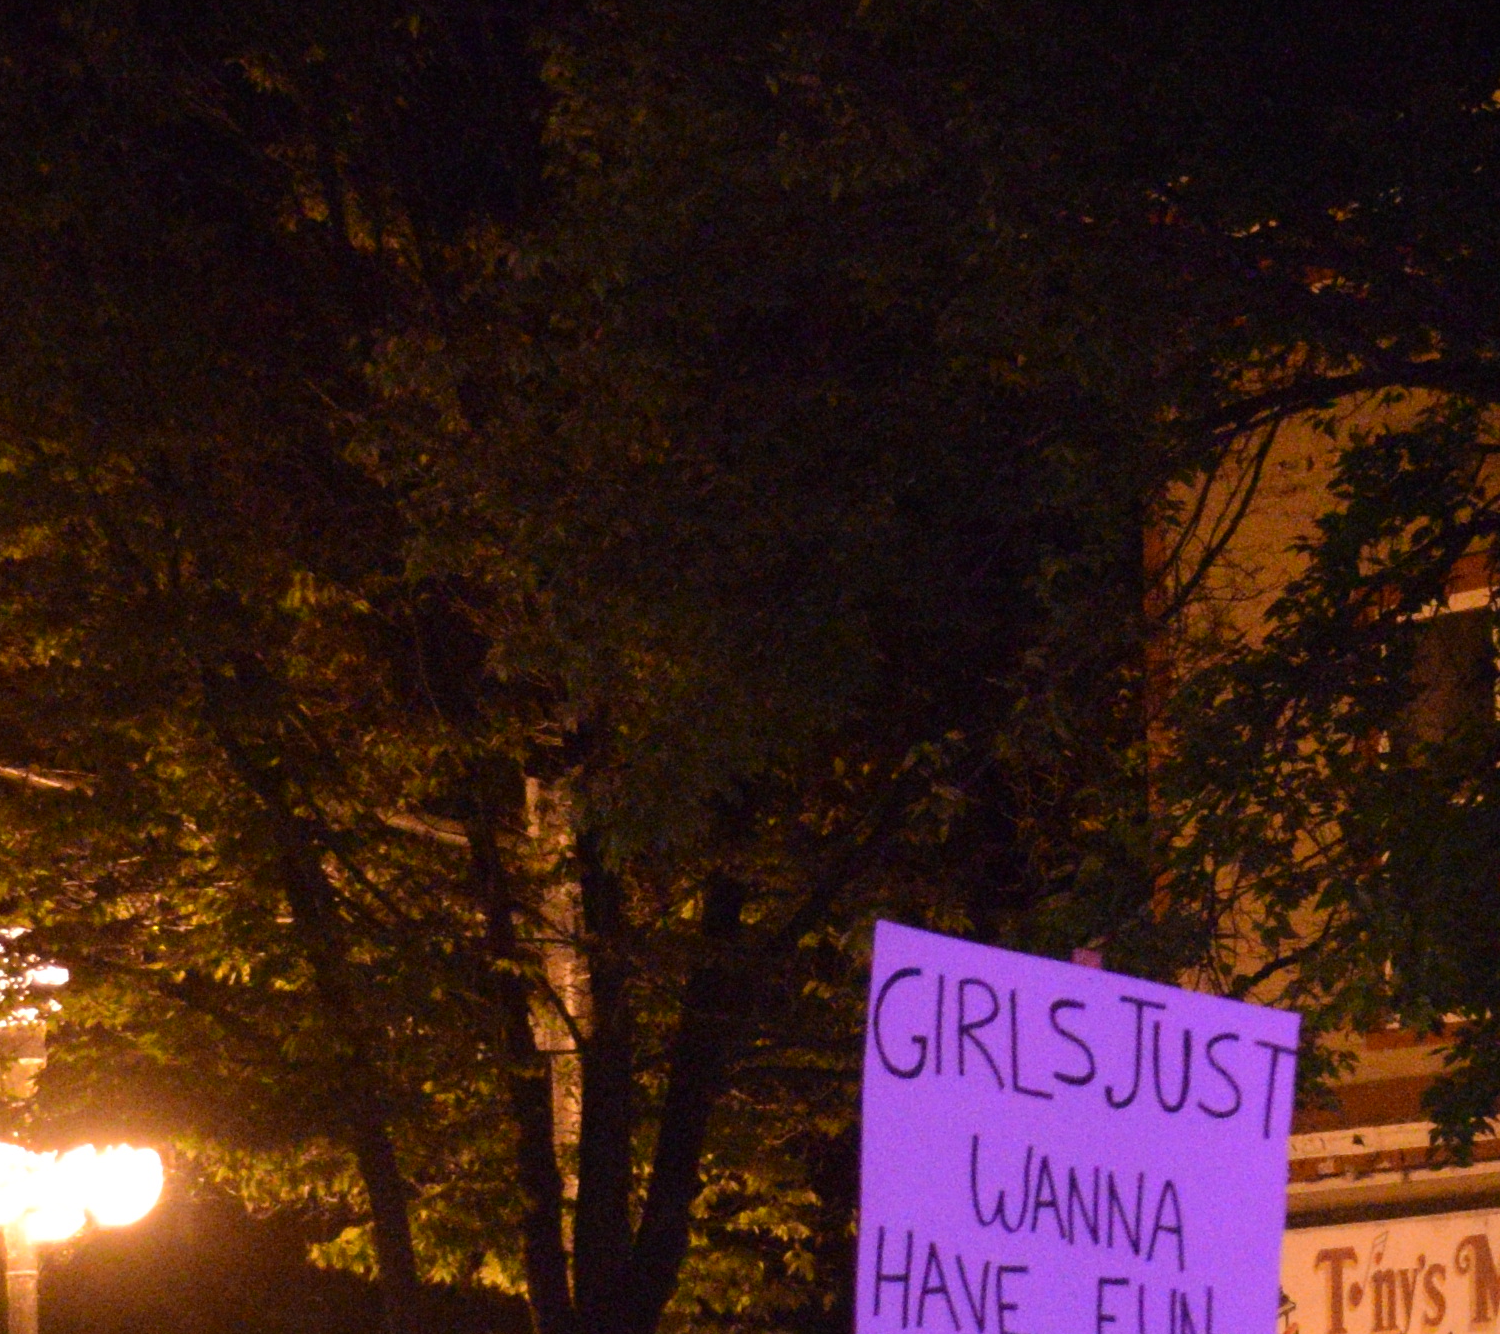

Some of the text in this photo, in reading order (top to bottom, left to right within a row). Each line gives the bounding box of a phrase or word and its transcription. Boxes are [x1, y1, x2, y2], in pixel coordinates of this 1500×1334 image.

[873, 967, 1299, 1139] GIRLS JUST
[972, 1134, 1186, 1272] WANNA
